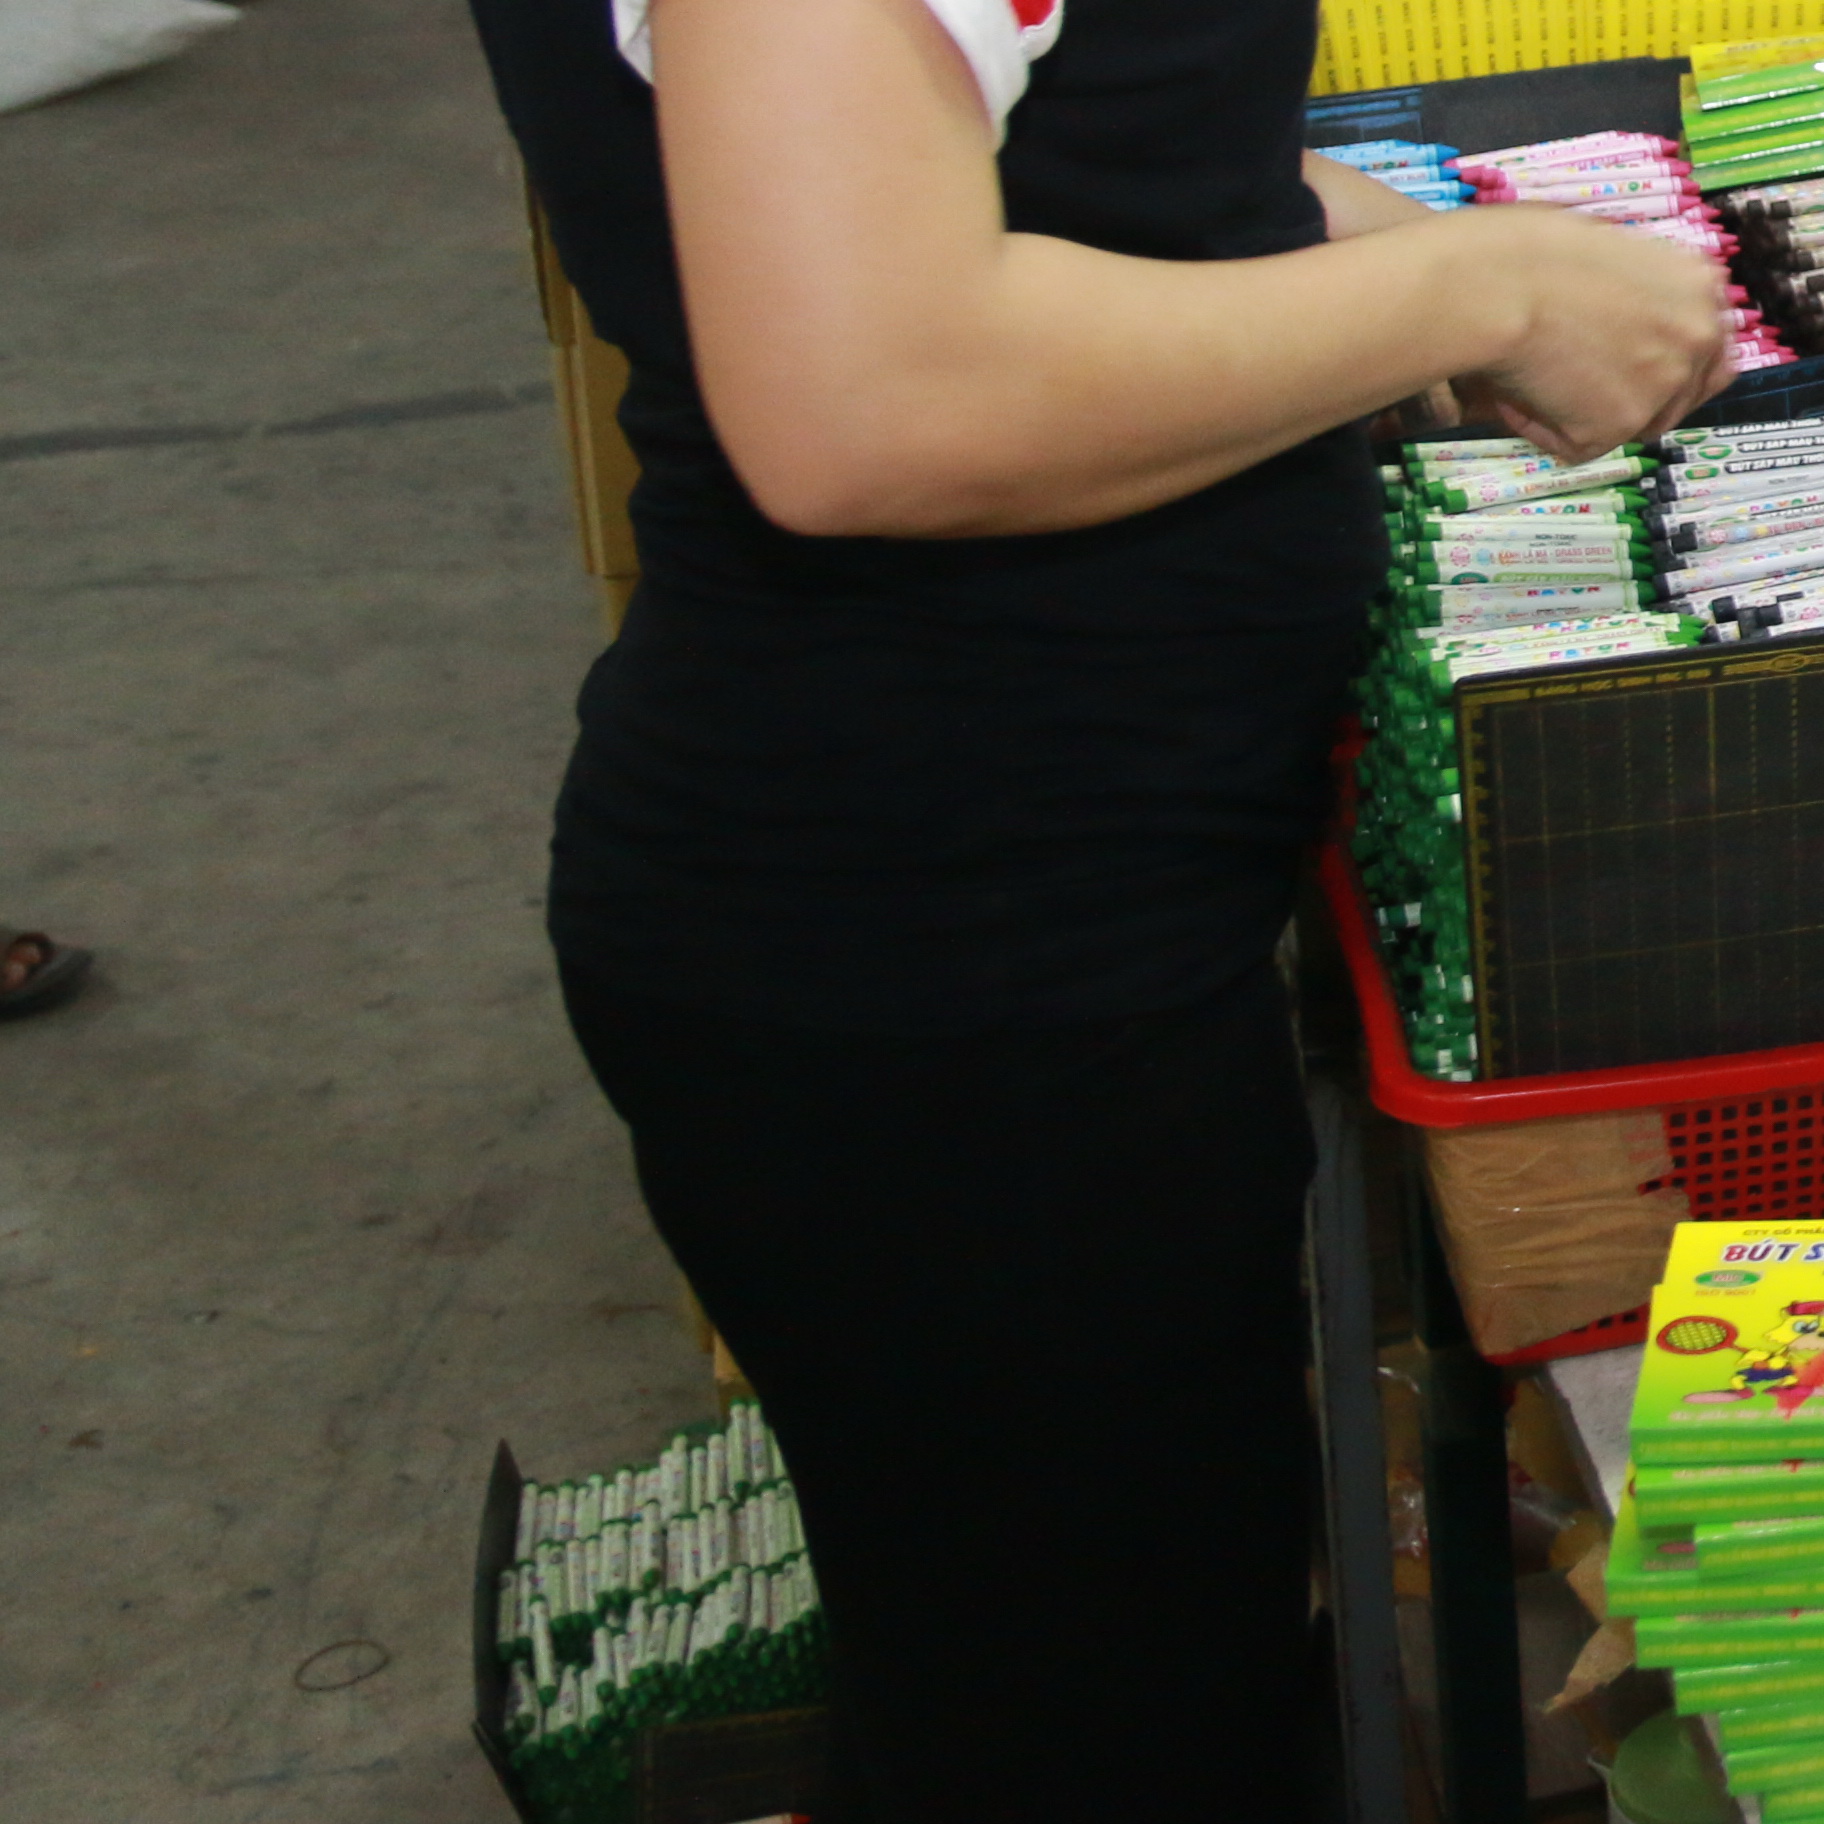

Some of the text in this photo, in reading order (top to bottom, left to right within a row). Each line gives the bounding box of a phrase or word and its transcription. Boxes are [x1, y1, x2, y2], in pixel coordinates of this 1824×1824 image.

[1578, 180, 1652, 197] CRAYON
[1555, 547, 1583, 558] GRASS
[1585, 547, 1613, 557] GREEN
[1724, 1239, 1799, 1262] BÚT
